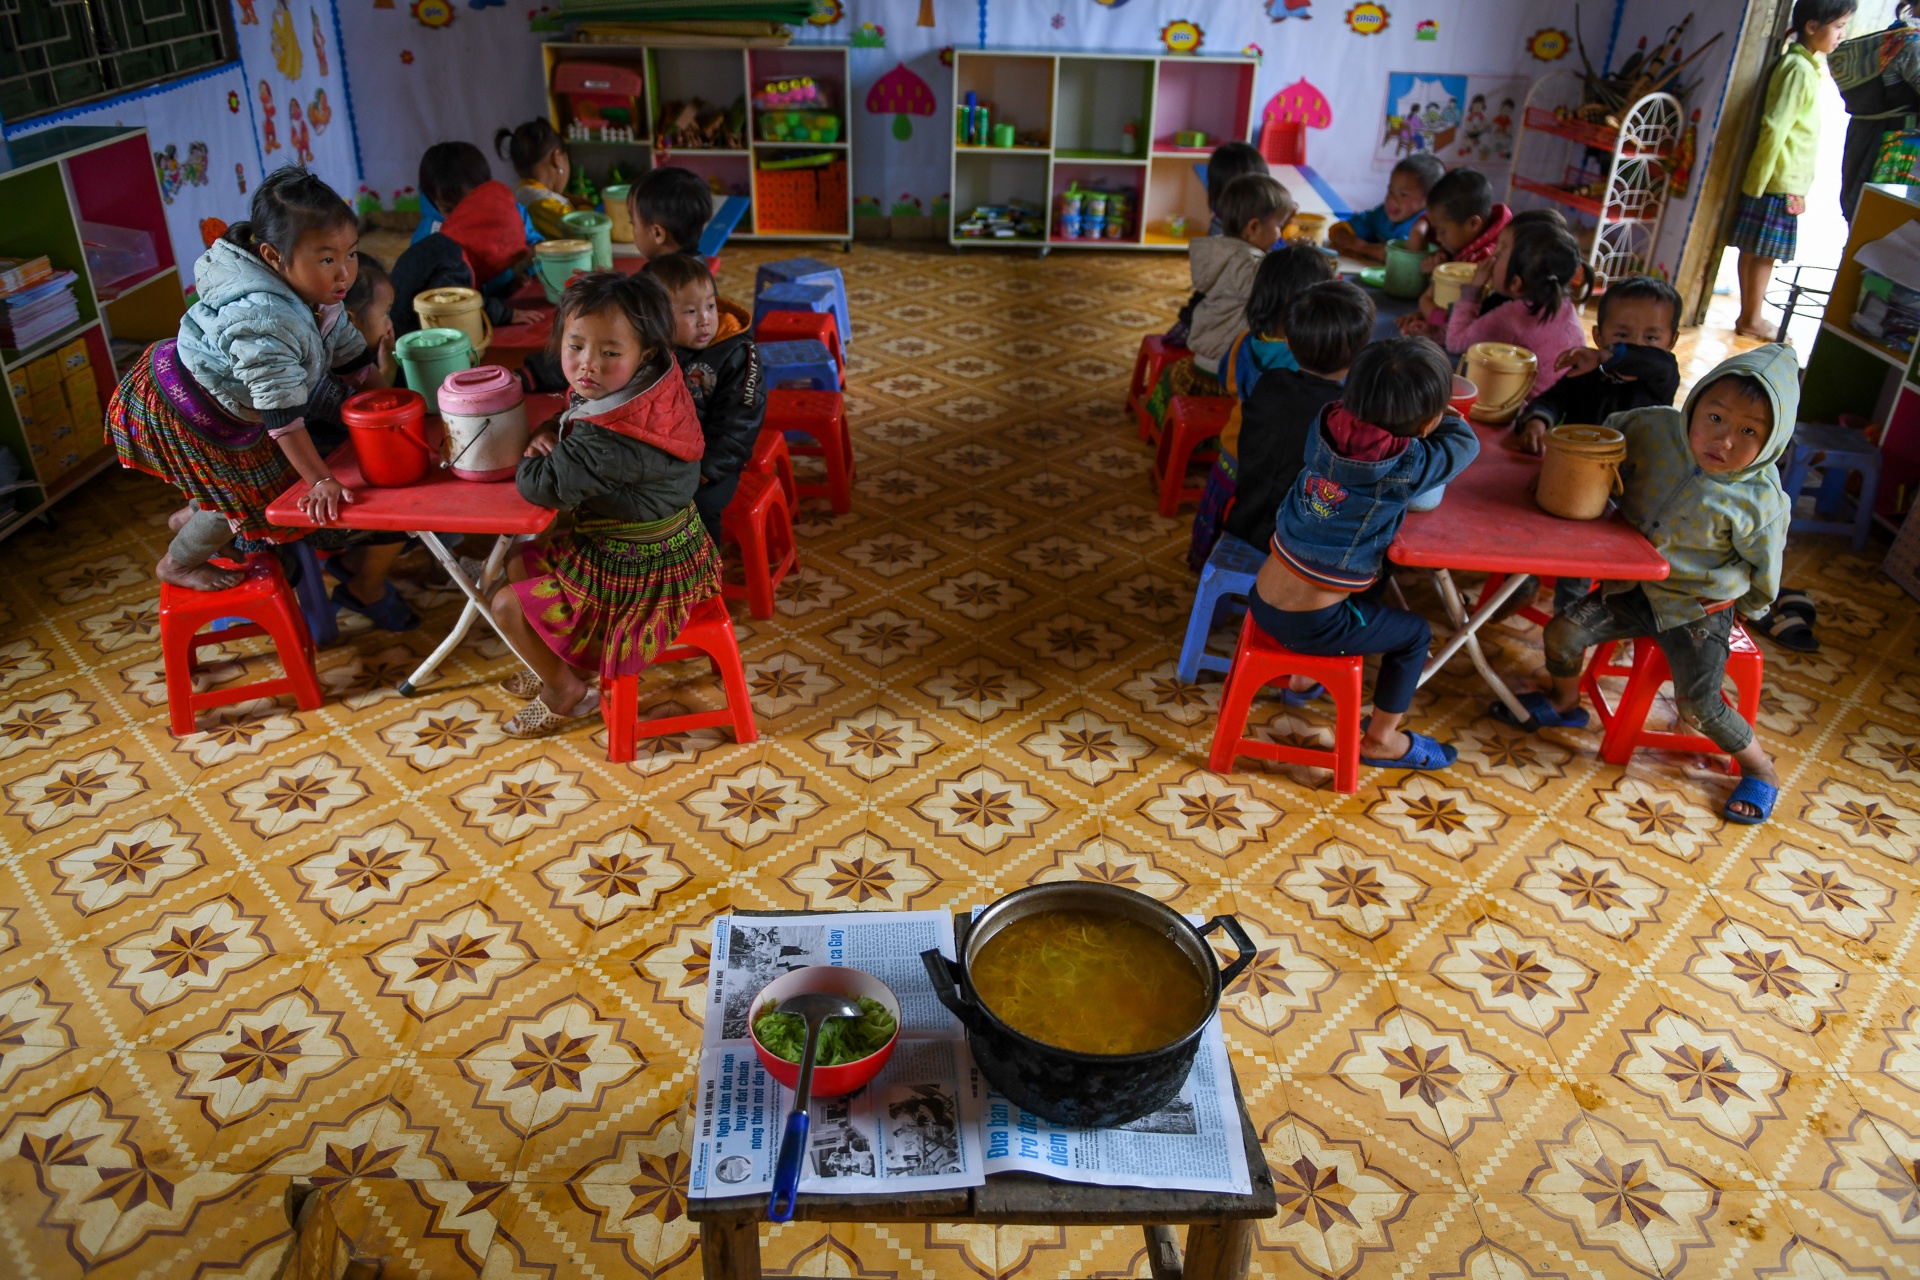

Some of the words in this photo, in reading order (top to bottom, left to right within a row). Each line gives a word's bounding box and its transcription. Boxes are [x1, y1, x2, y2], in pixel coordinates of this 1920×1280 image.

[743, 360, 758, 406] JINGPIN
[830, 949, 843, 960] ca
[720, 1075, 733, 1090] đón
[718, 1093, 731, 1115] Xuân
[735, 1088, 750, 1103] đạt
[733, 1104, 749, 1132] huyện
[751, 1106, 763, 1125] thôn
[984, 1104, 1008, 1127] bản
[716, 1117, 731, 1138] Nghi
[750, 1127, 764, 1150] nông
[986, 1131, 1009, 1159] Đưa
[1014, 1135, 1039, 1160] trở
[1043, 1133, 1069, 1167] điểm
